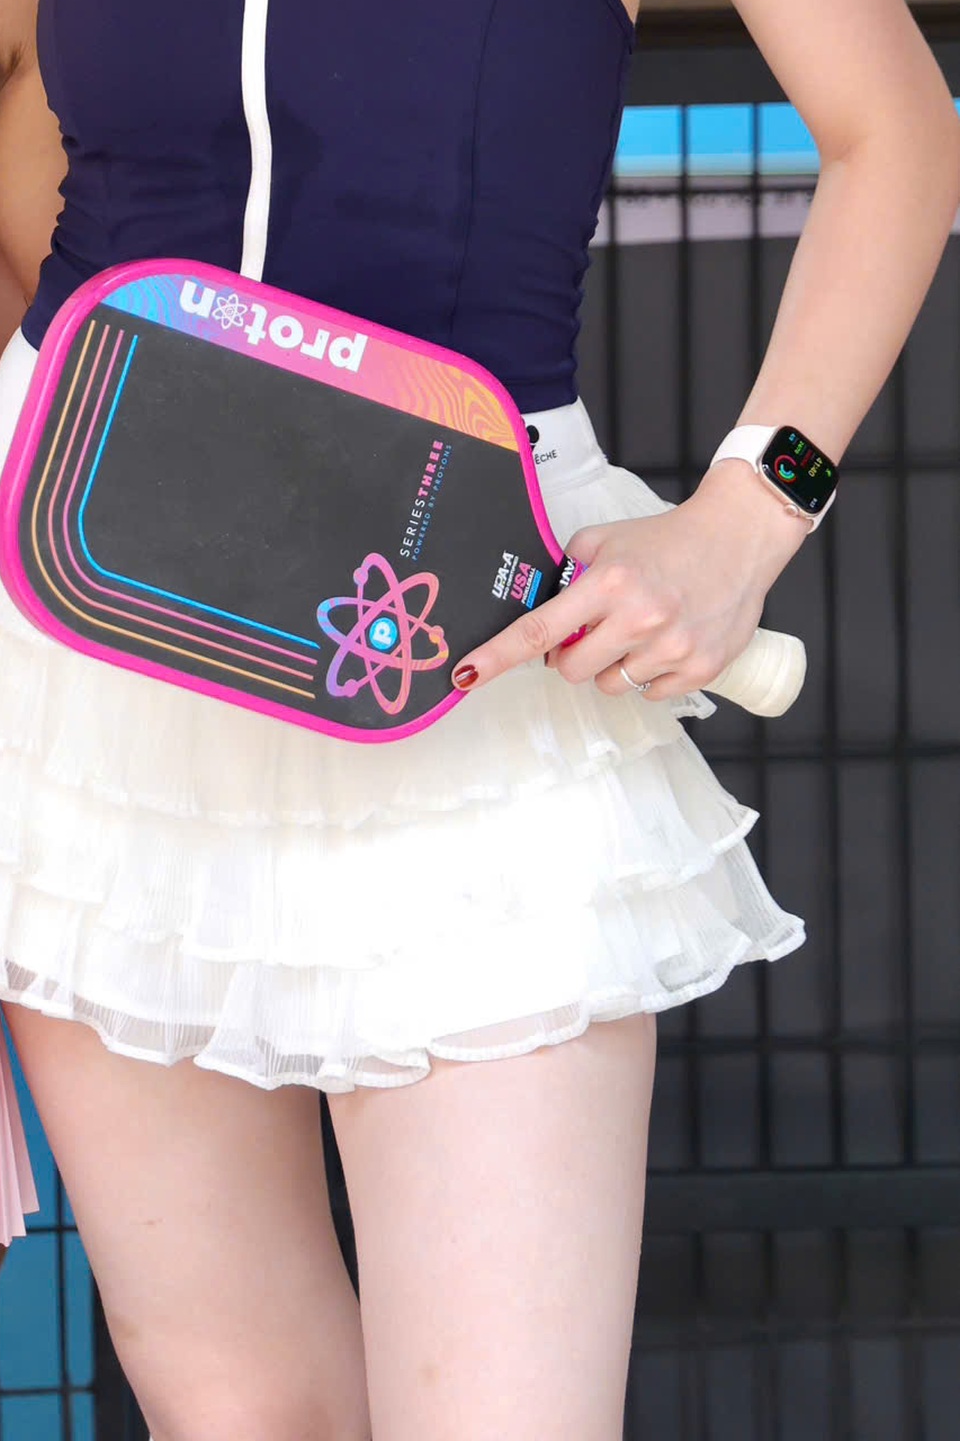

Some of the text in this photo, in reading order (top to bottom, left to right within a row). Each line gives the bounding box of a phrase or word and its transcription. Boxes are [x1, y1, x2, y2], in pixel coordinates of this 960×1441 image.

[179, 280, 368, 373] proton
[534, 450, 558, 465] ÊCHE
[412, 444, 452, 561] POWERED BY PROTONS
[510, 562, 531, 600] USA
